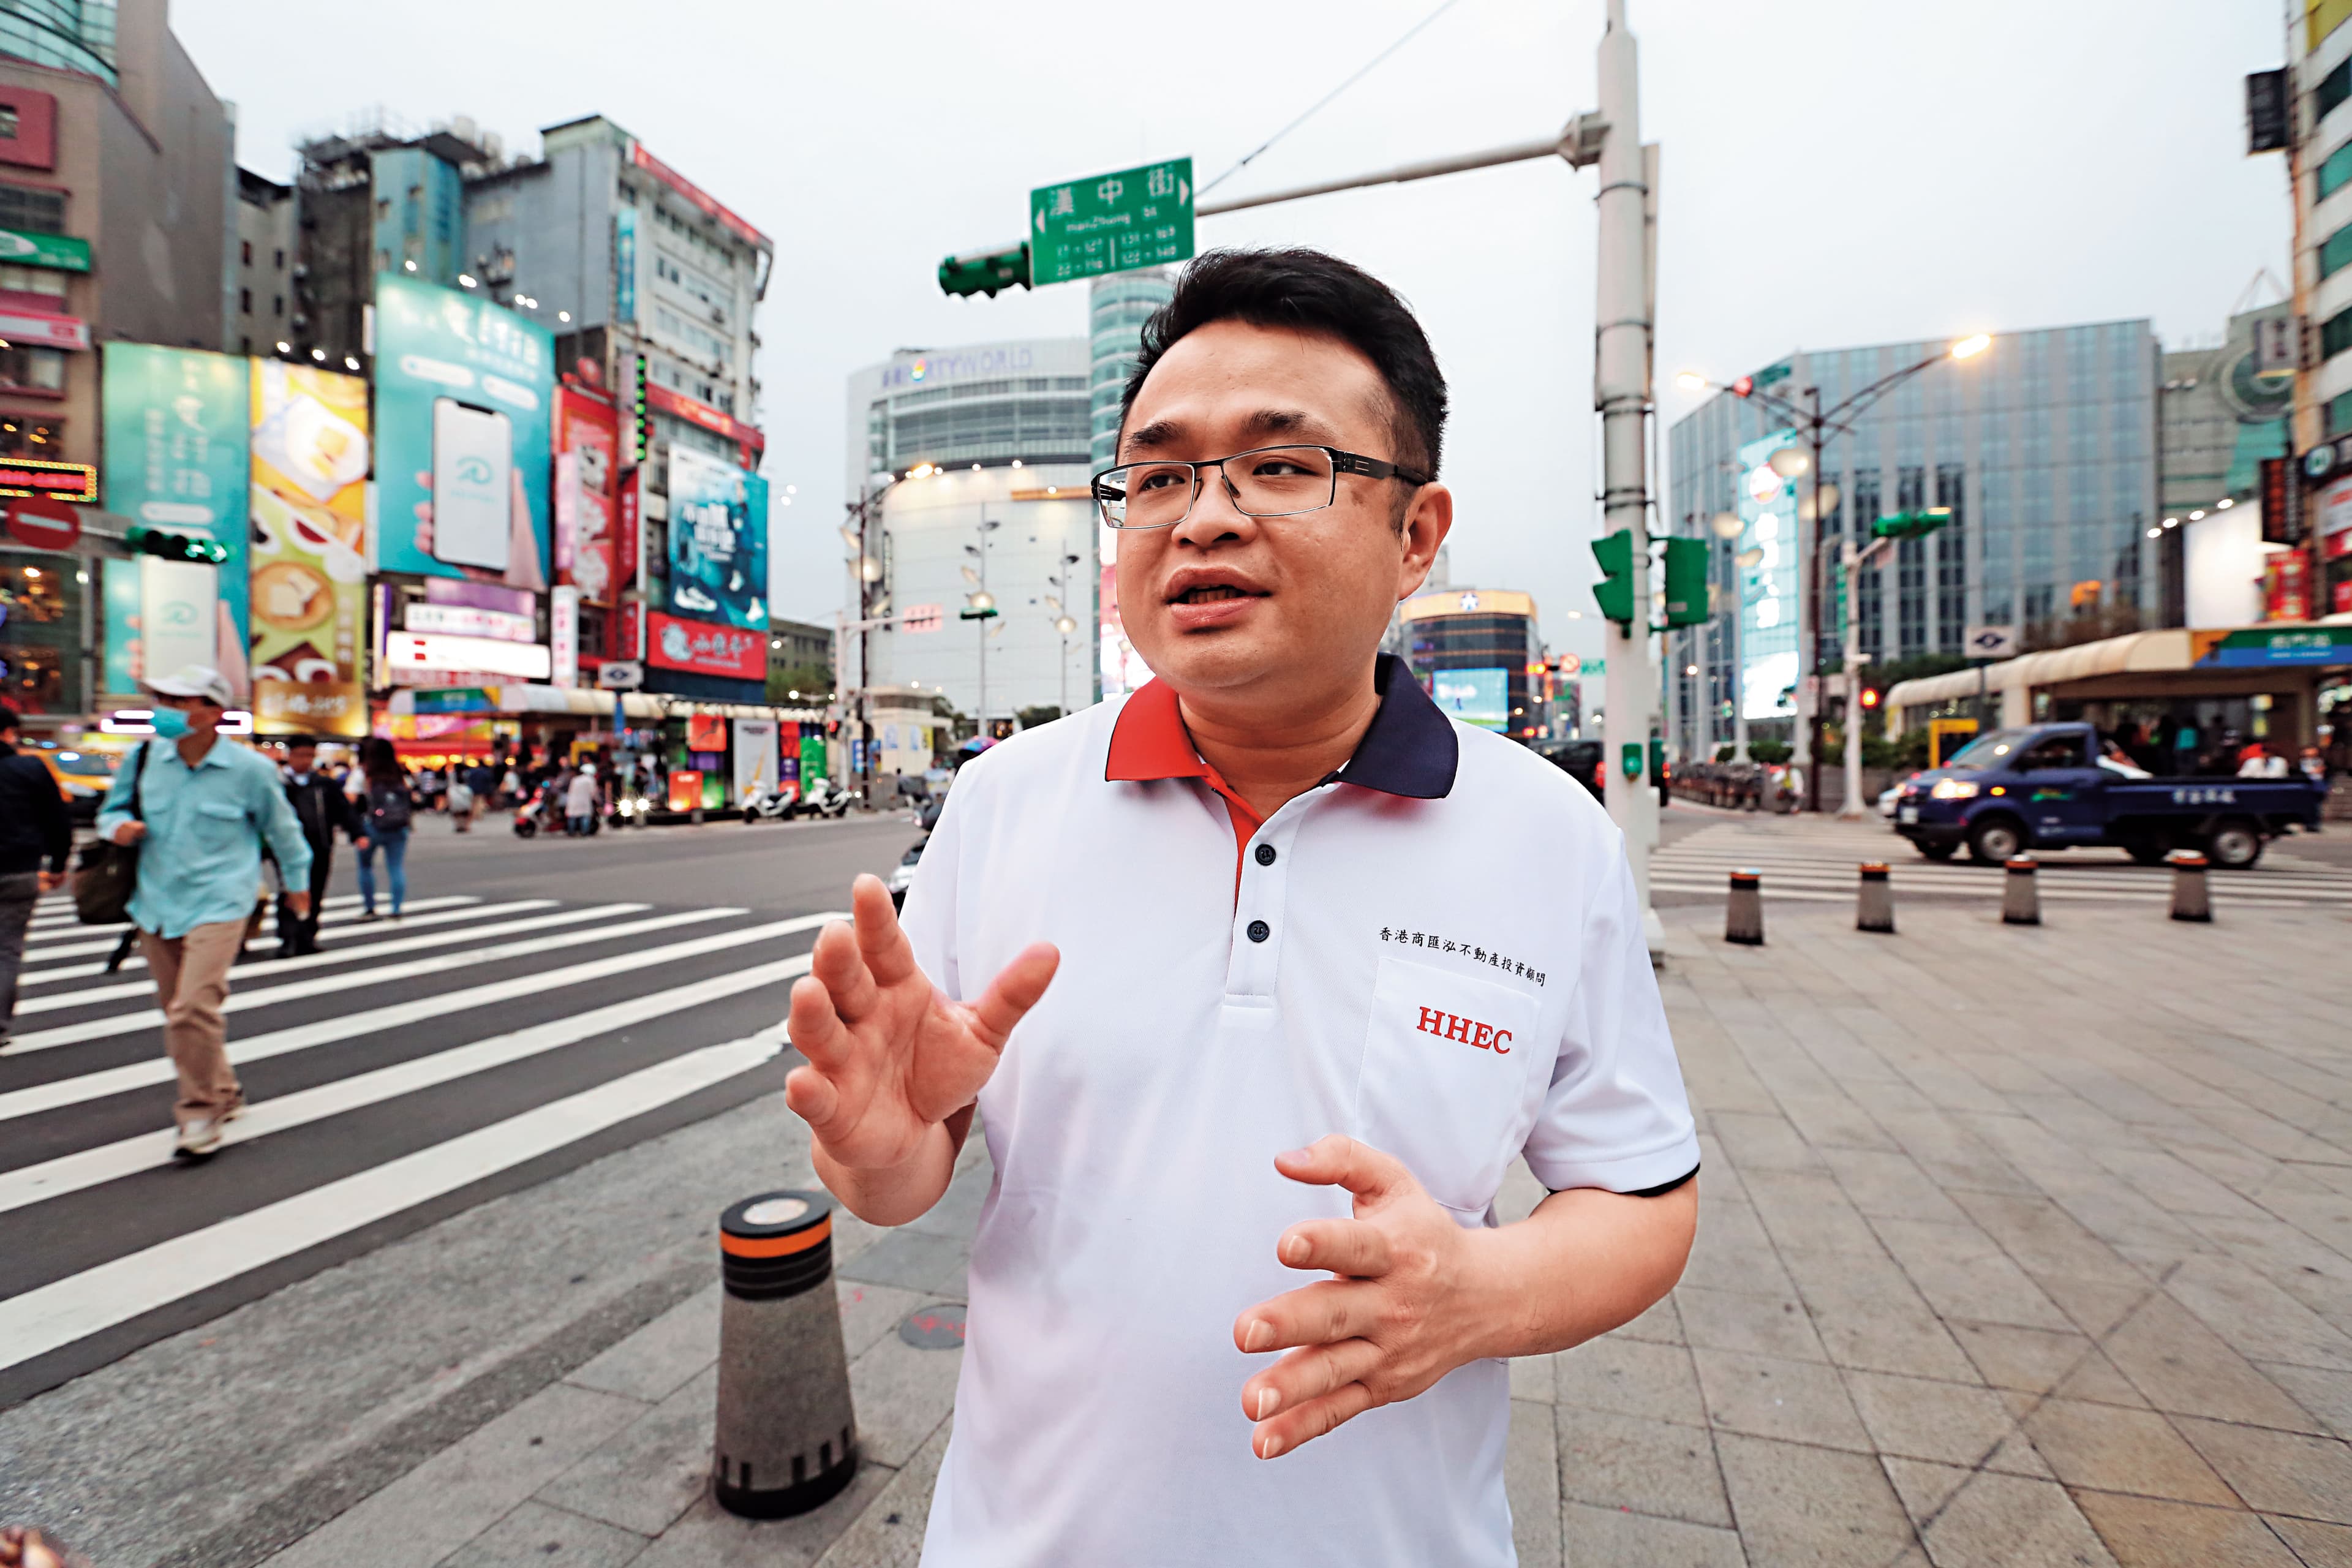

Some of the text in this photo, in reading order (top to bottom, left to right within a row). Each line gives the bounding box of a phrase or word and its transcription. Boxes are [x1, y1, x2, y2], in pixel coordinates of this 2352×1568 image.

[1379, 927, 1546, 987] 香港商匯泓不動產投資顧問
[1416, 1006, 1512, 1054] HHEC
